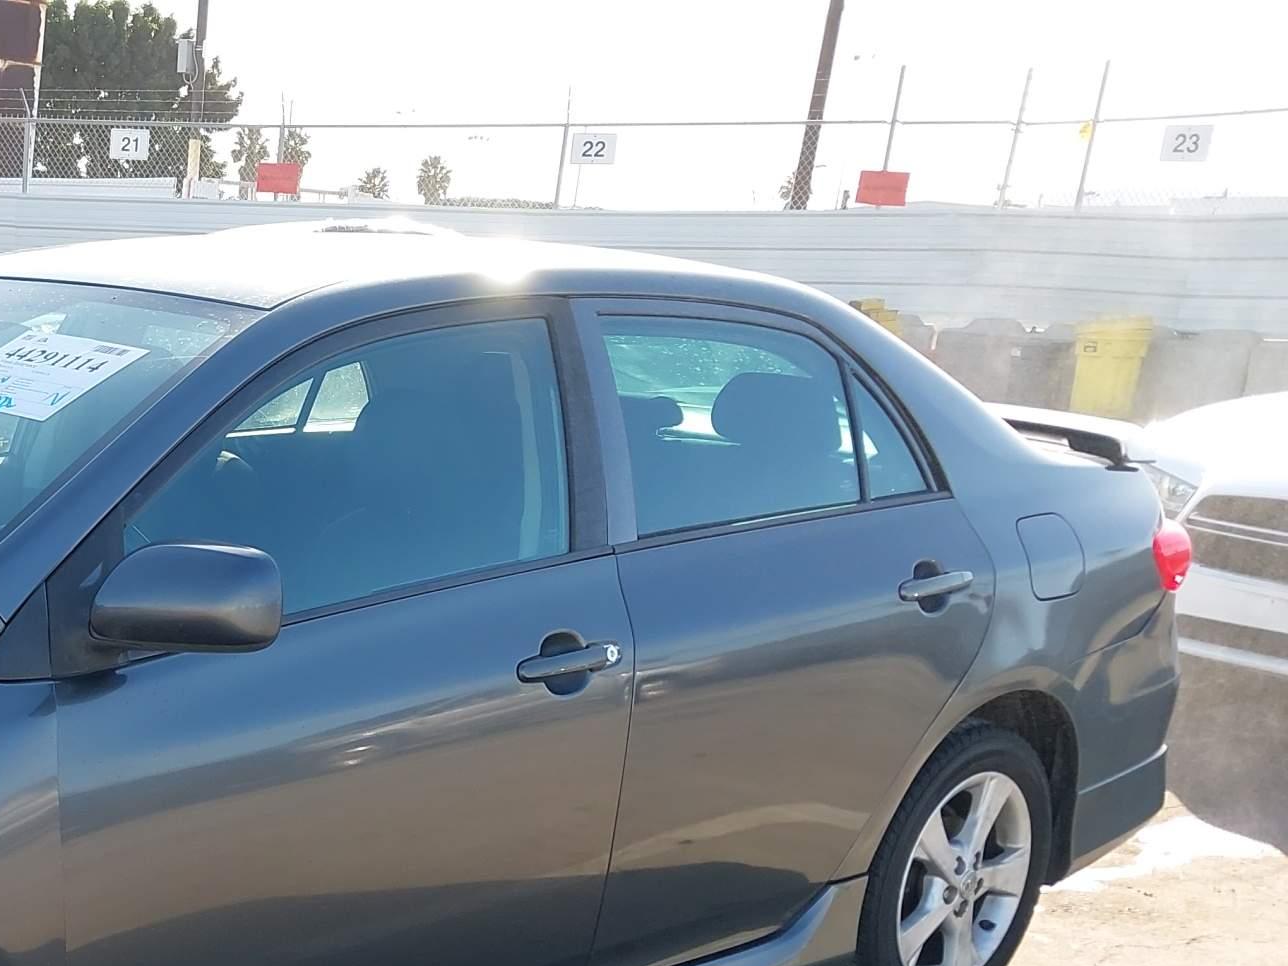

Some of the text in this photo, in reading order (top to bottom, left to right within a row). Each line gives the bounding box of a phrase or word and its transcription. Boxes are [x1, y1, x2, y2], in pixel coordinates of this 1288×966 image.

[120, 136, 140, 153] 21
[581, 140, 606, 158] 22
[1172, 133, 1201, 155] 23
[5, 346, 109, 373] 44291114
